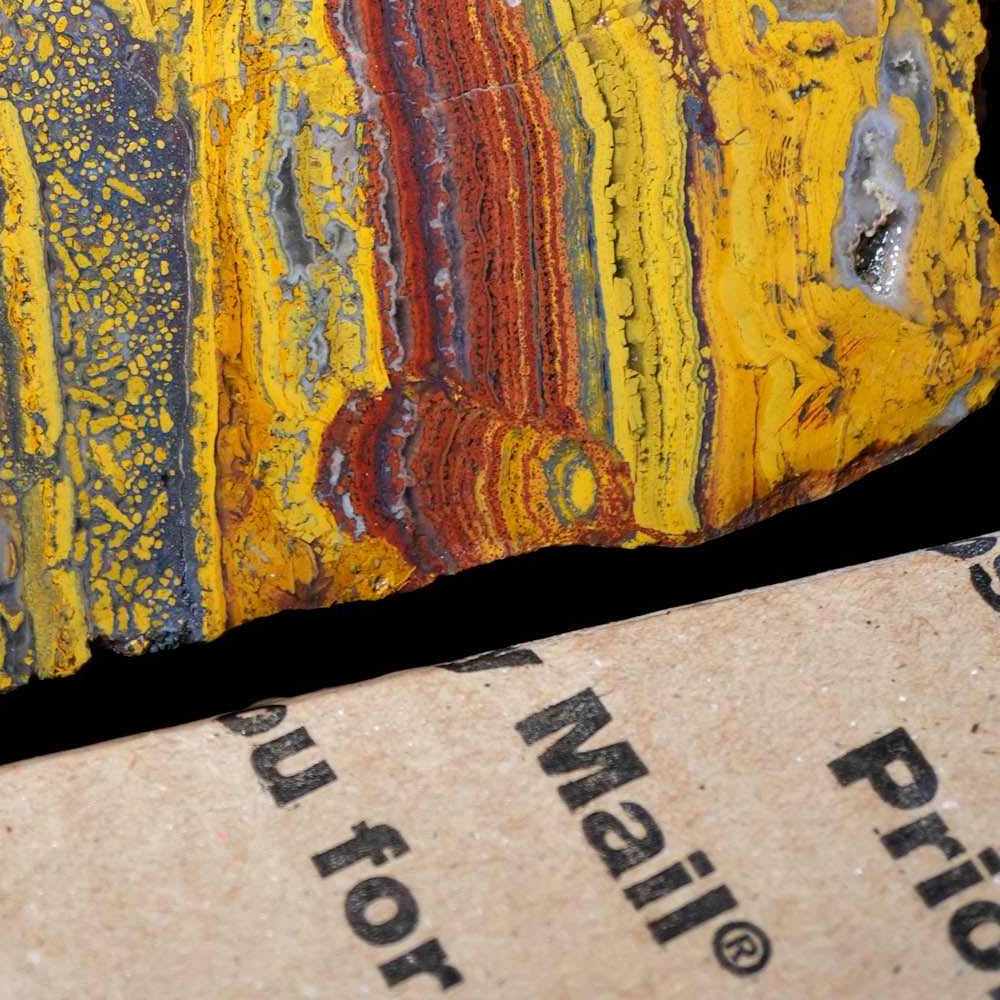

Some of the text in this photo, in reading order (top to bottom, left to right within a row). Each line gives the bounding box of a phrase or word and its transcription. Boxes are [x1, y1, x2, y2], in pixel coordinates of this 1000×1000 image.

[310, 820, 464, 992] for
[515, 687, 772, 976] Mail®
[827, 727, 1000, 1000] Prio
